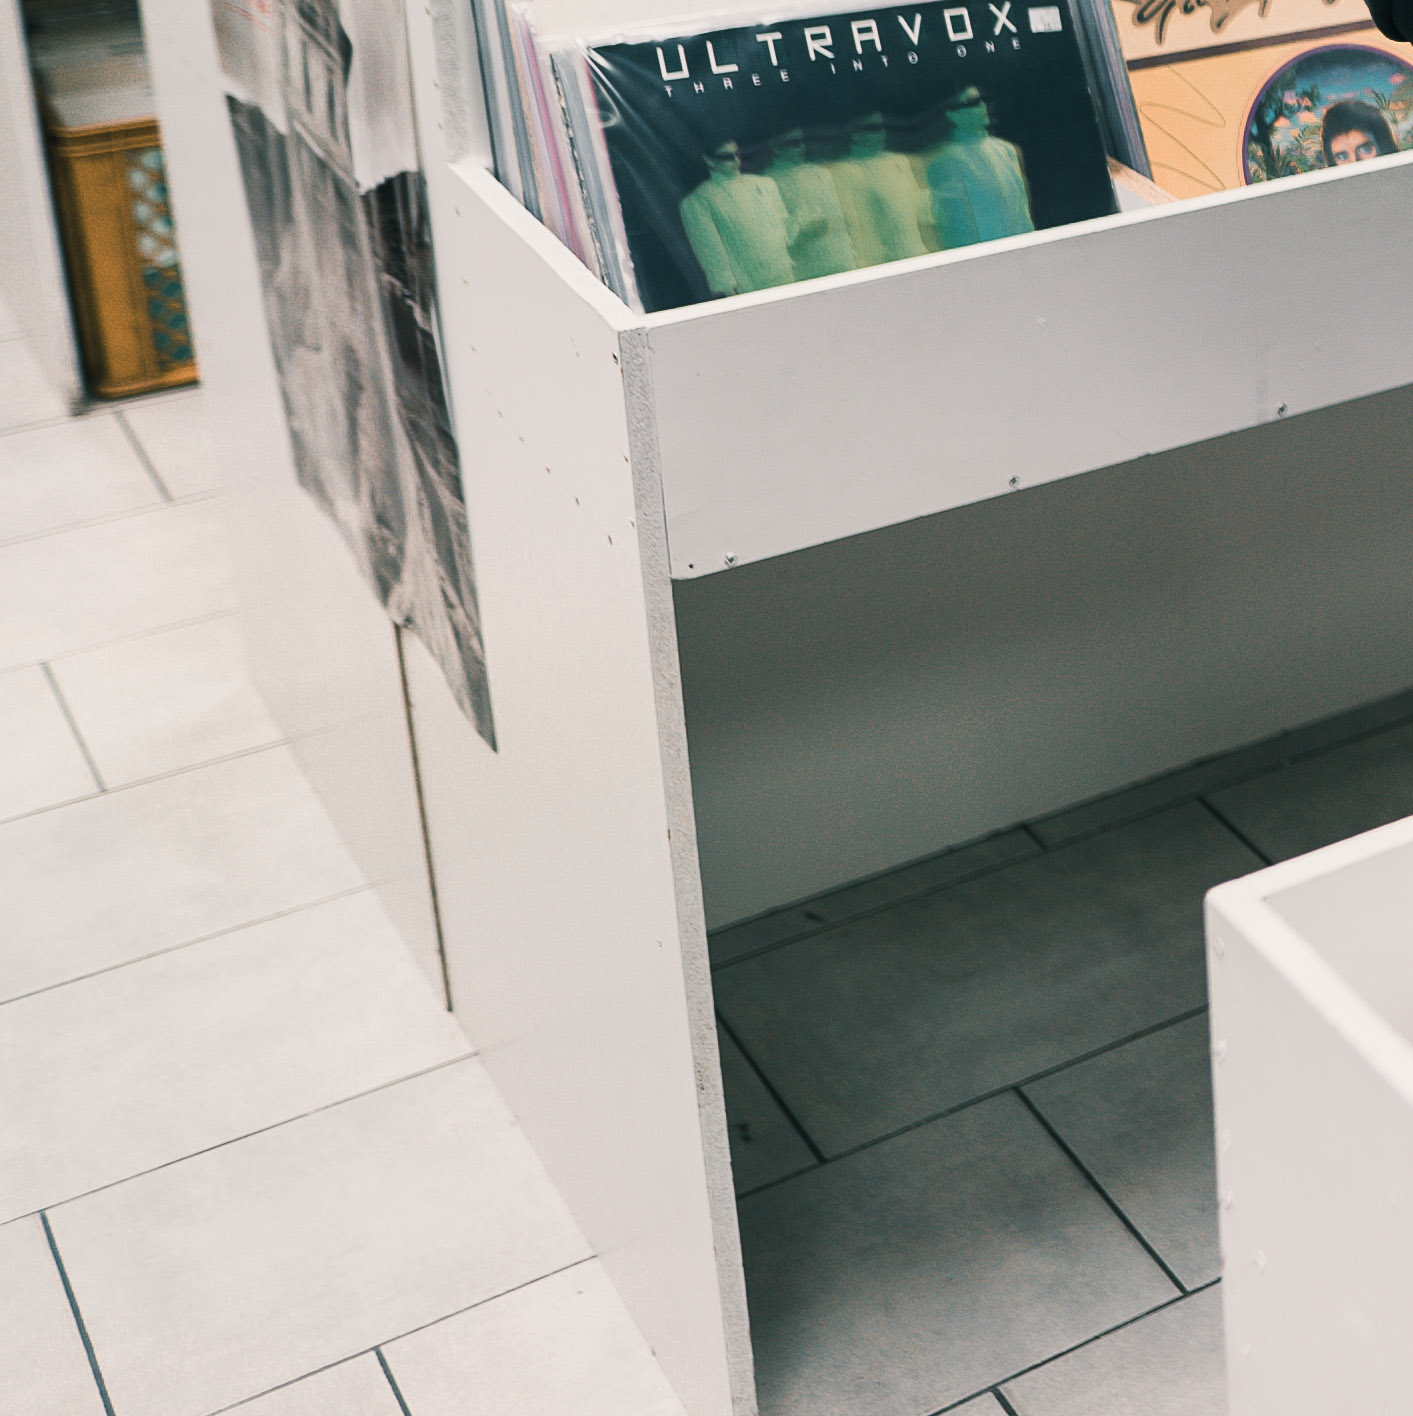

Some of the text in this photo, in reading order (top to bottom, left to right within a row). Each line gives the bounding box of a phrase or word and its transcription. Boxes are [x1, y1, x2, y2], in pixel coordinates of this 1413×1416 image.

[655, 0, 1018, 82] ULTRAVOX
[664, 37, 1022, 98] THREE INTO ONE
